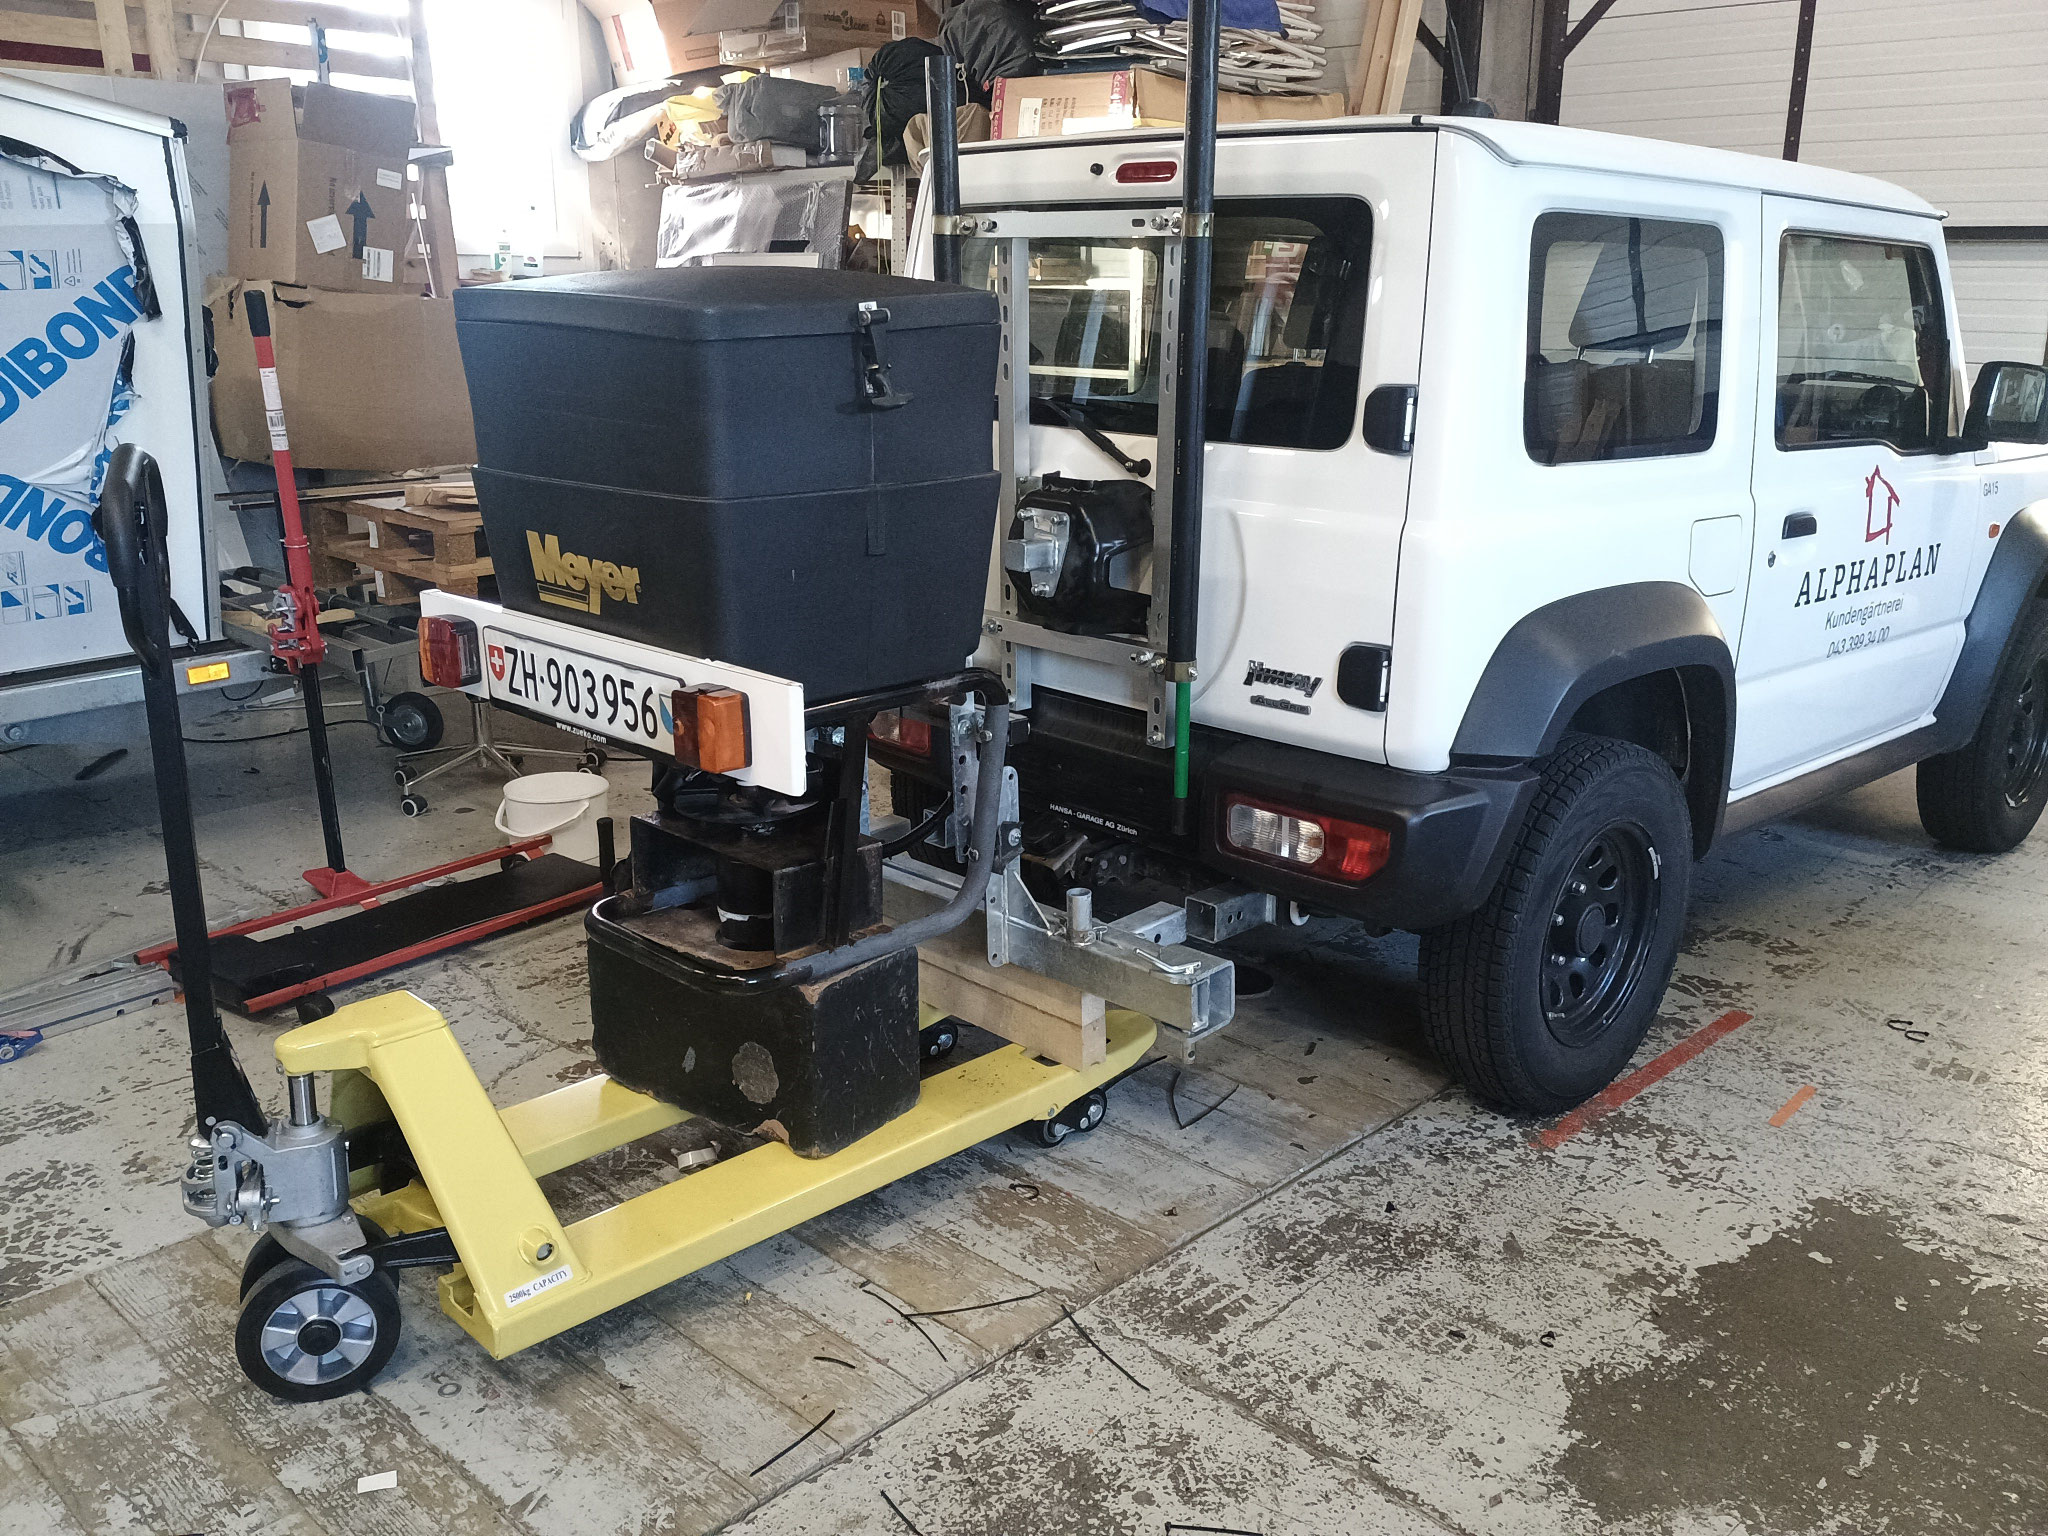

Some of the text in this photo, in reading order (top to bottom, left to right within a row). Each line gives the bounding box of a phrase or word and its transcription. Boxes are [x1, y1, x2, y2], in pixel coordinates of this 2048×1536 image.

[526, 530, 641, 615] Meyer
[1794, 543, 1942, 608] ALPHAPLAN
[1825, 593, 1905, 631] Kundengärtnerei
[1826, 626, 1891, 658] 043 399 34 00
[555, 721, 607, 744] www.zueko.com
[1049, 803, 1073, 816] HANSA
[1076, 811, 1104, 826] GARAGE
[1105, 820, 1115, 829] AG
[1116, 823, 1138, 836] Zürich
[509, 1270, 568, 1303] 2500kg CAPACITY
